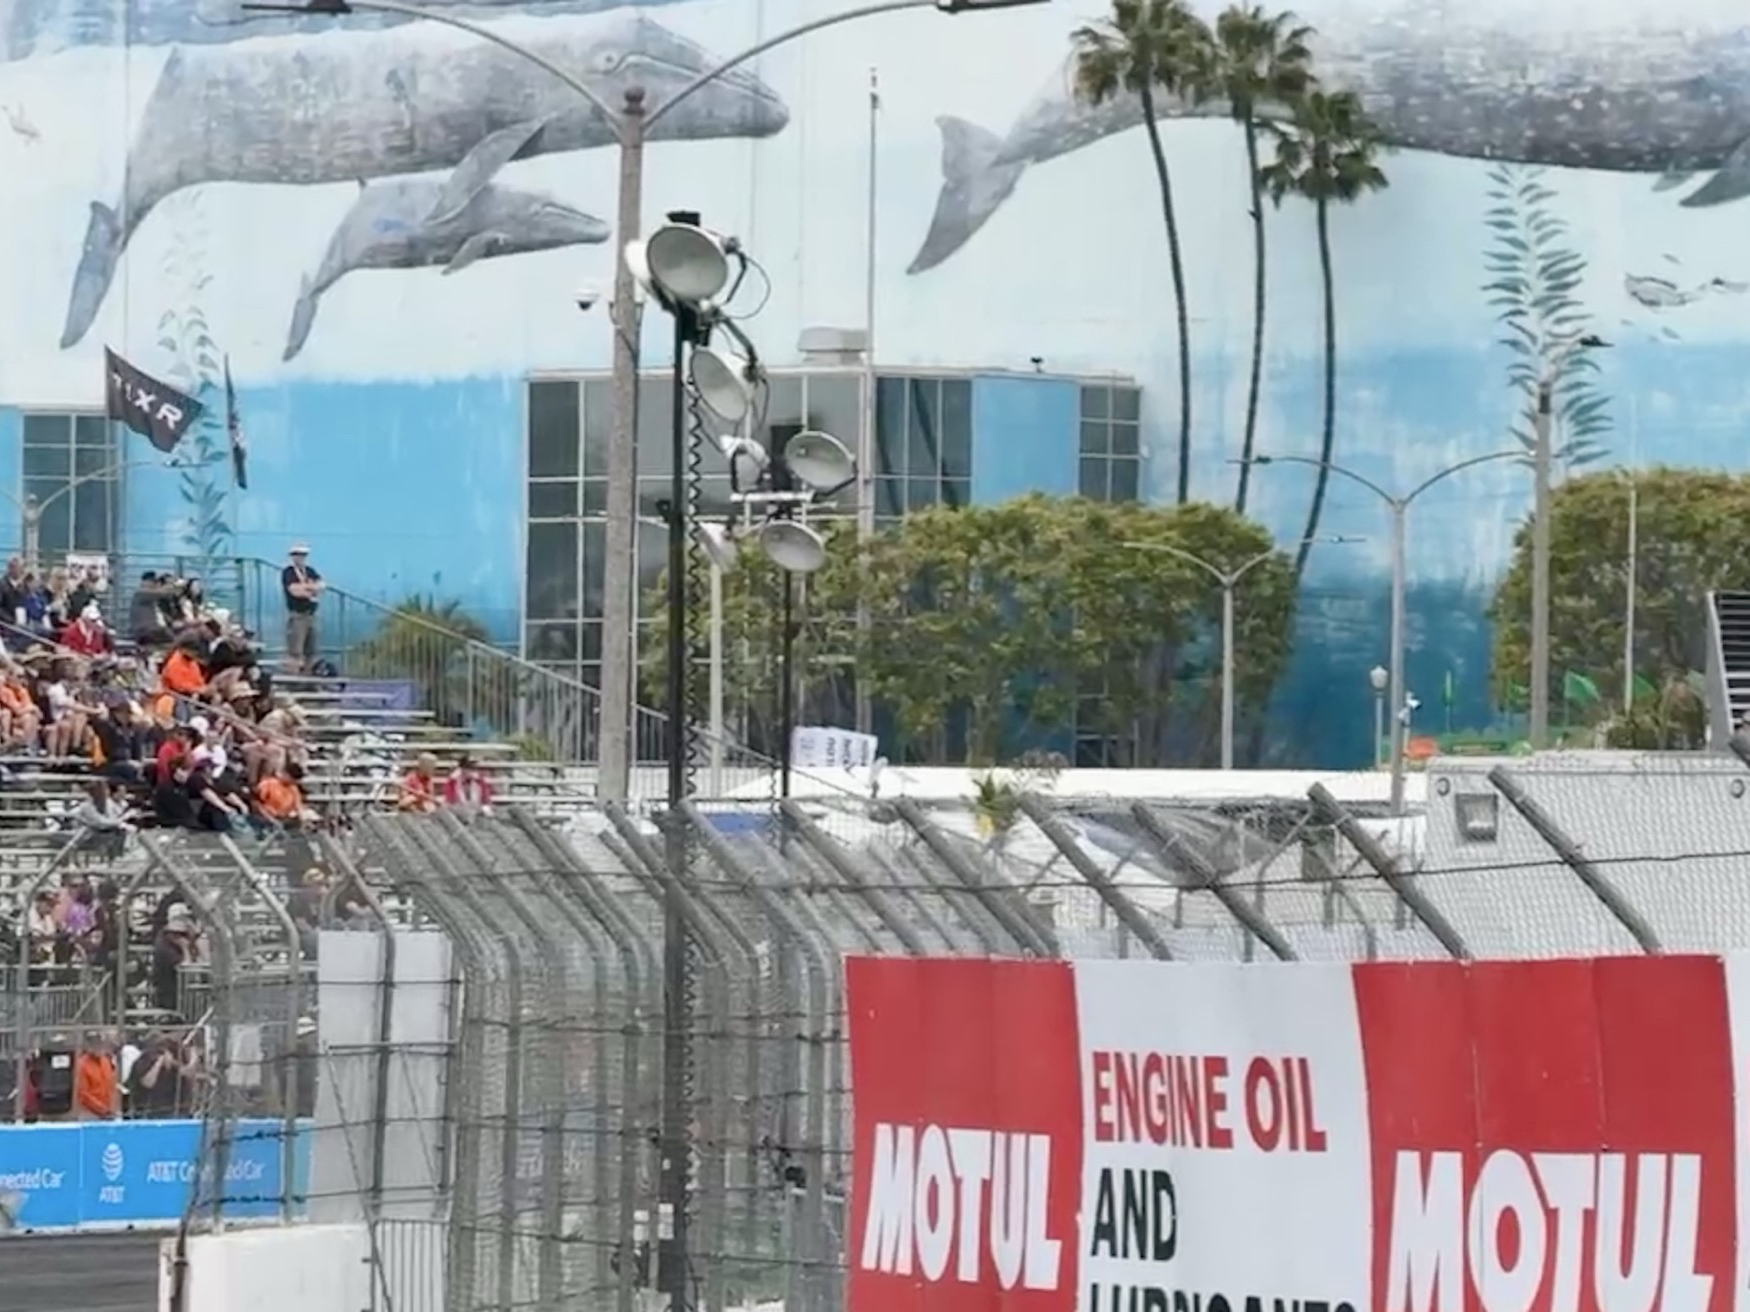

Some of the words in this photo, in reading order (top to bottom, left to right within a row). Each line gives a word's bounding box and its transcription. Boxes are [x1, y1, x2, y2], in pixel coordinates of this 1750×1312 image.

[1094, 1051, 1234, 1150] ENGINE
[1245, 1056, 1327, 1153] OIL
[862, 1122, 1062, 1291] MOTUL
[1090, 1168, 1178, 1262] AND
